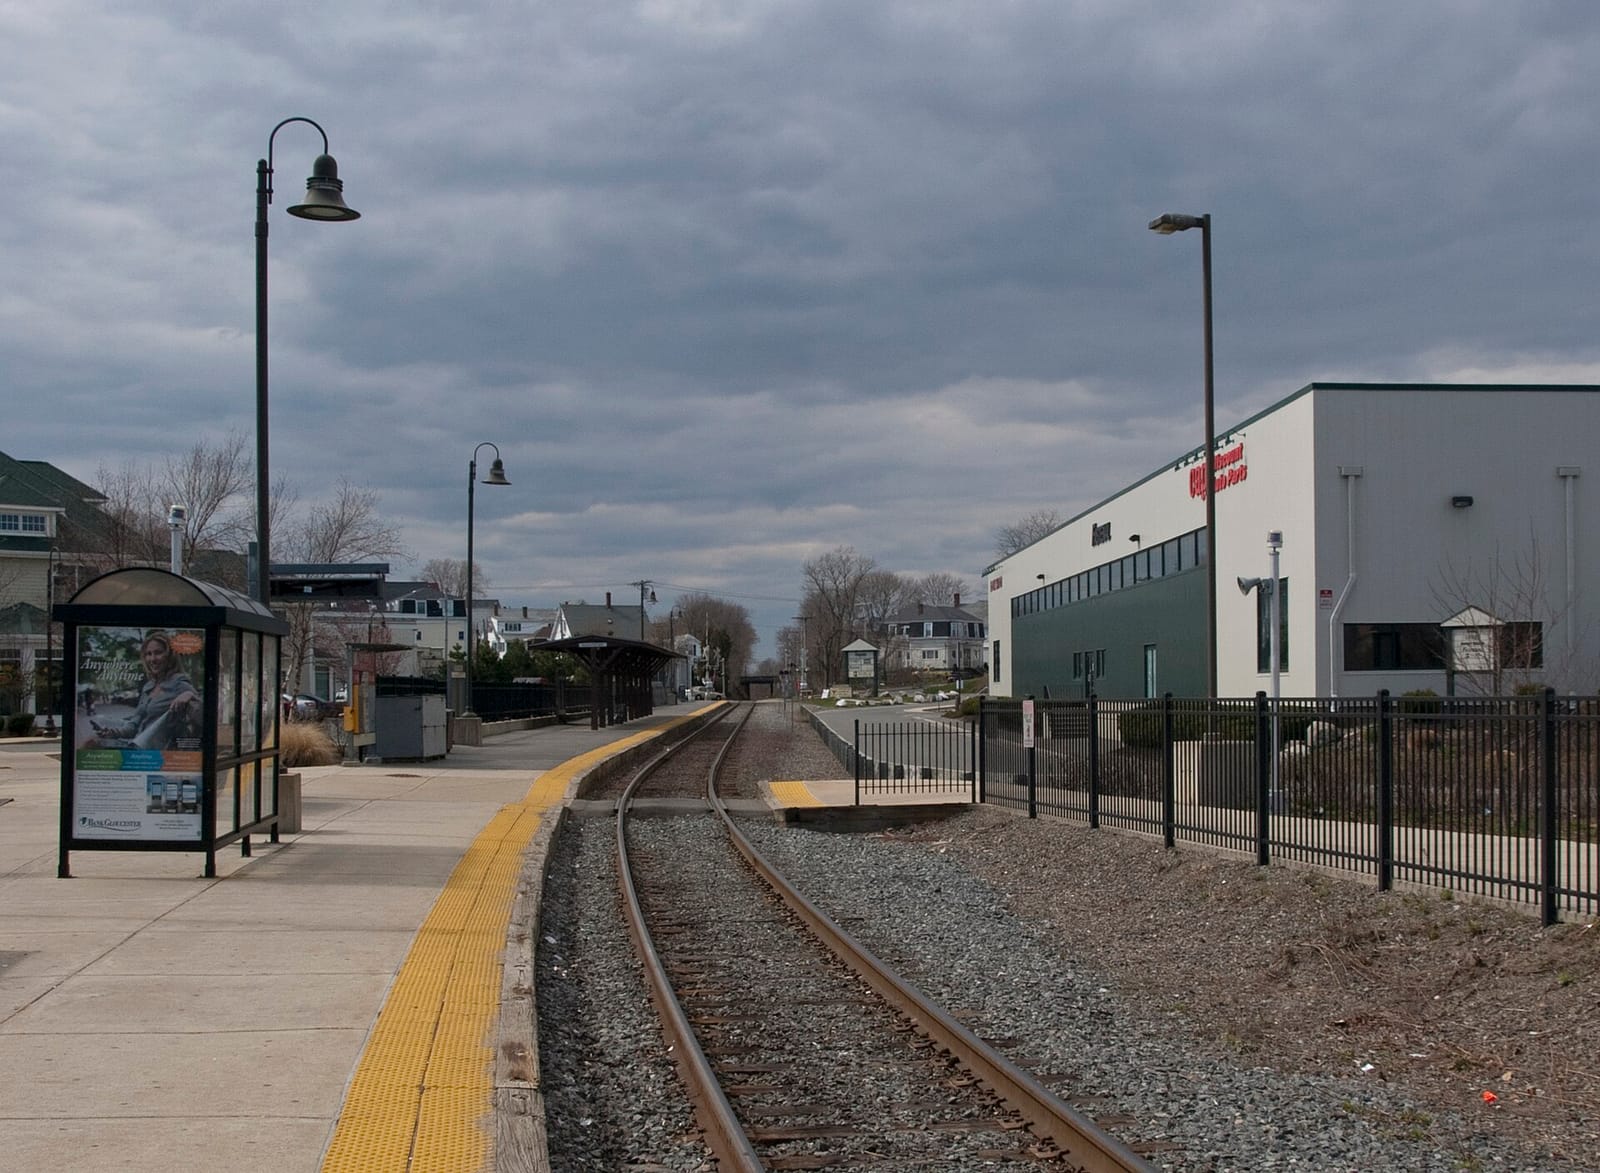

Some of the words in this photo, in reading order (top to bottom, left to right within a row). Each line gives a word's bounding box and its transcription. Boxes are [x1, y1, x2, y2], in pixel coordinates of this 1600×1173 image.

[1214, 442, 1243, 471] iscount
[1228, 464, 1248, 487] Parts
[80, 658, 135, 673] Anywhere
[97, 669, 144, 681] Anytime
